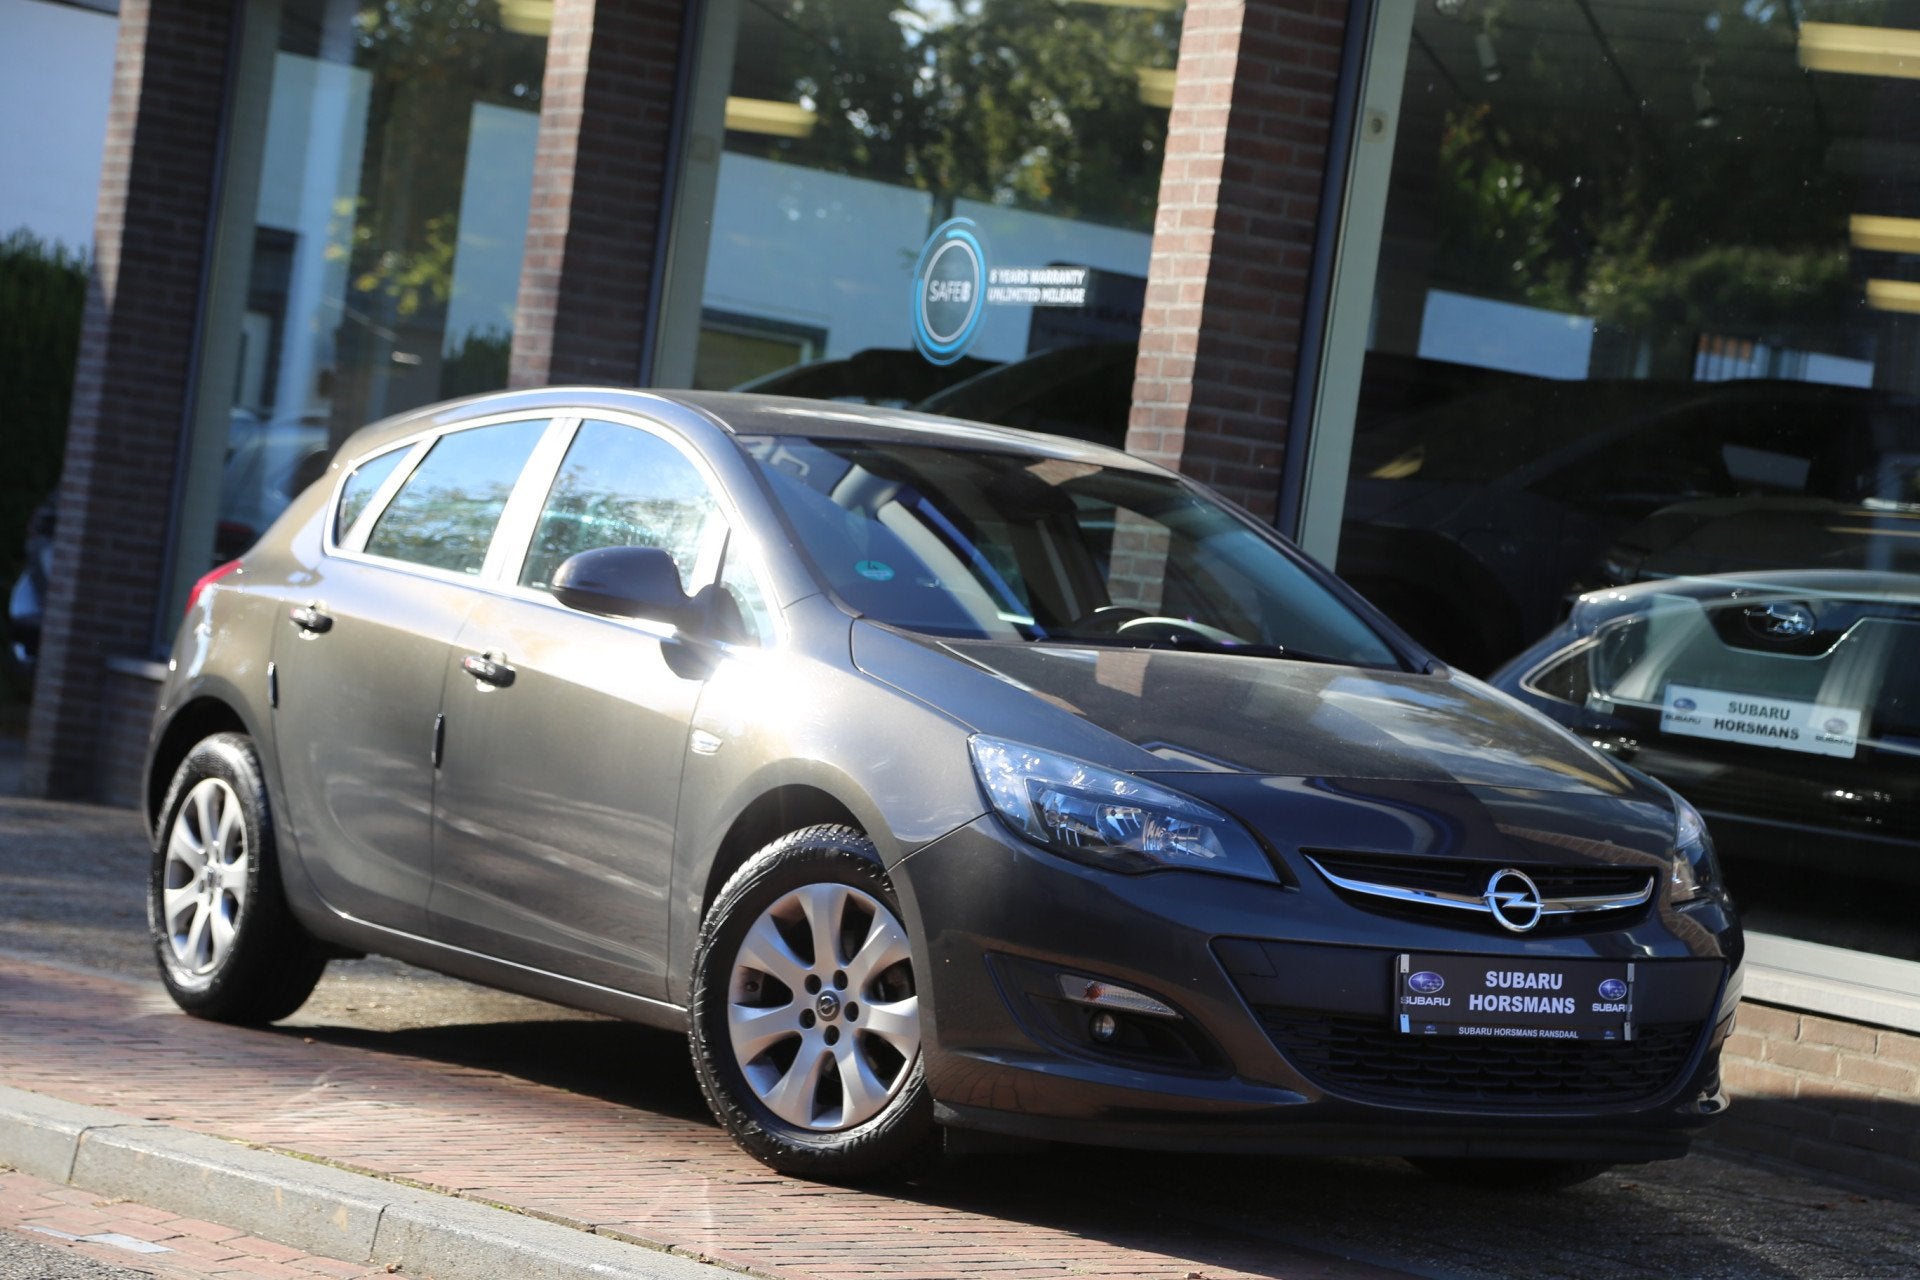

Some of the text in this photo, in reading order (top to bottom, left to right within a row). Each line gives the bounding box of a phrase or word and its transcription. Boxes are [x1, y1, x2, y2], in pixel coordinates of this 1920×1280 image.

[1030, 270, 1085, 285] WARRANTY
[1041, 288, 1085, 303] MILEAGE
[1728, 701, 1791, 721] SUBARU
[1713, 718, 1799, 740] HORSMANS
[1485, 970, 1562, 989] SUBARU
[1400, 996, 1451, 1006] SUBARU
[1469, 994, 1575, 1014] HORSMANS
[1592, 1003, 1632, 1012] SUBARU
[1459, 1027, 1578, 1038] SUBARU HORSMANS RANSDAAL
